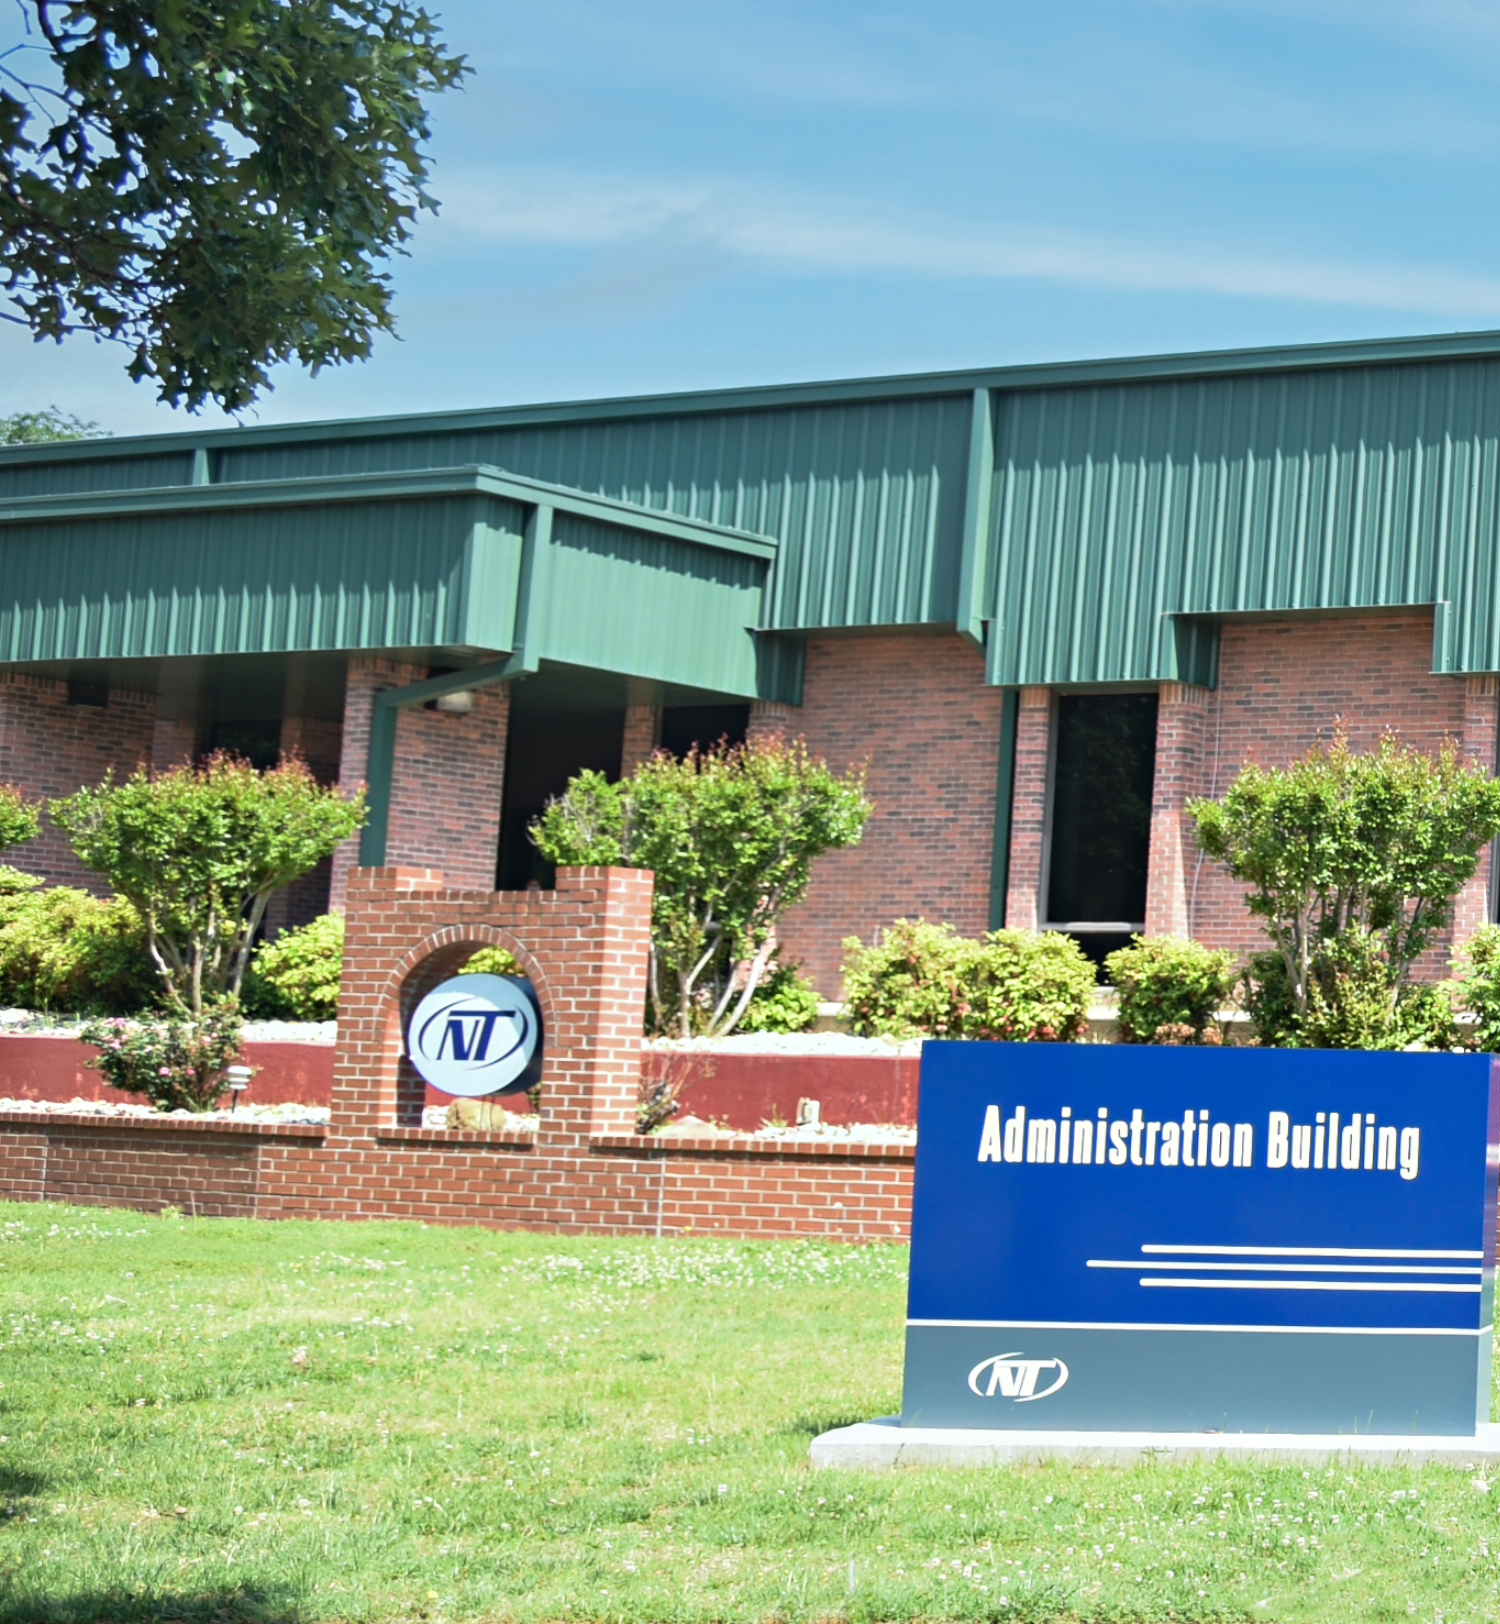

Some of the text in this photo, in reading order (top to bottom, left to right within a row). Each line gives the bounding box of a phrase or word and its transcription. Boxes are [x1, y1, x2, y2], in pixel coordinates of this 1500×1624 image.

[435, 1009, 517, 1062] NT
[977, 1104, 1421, 1181] Administration Building
[985, 1358, 1061, 1398] NT
